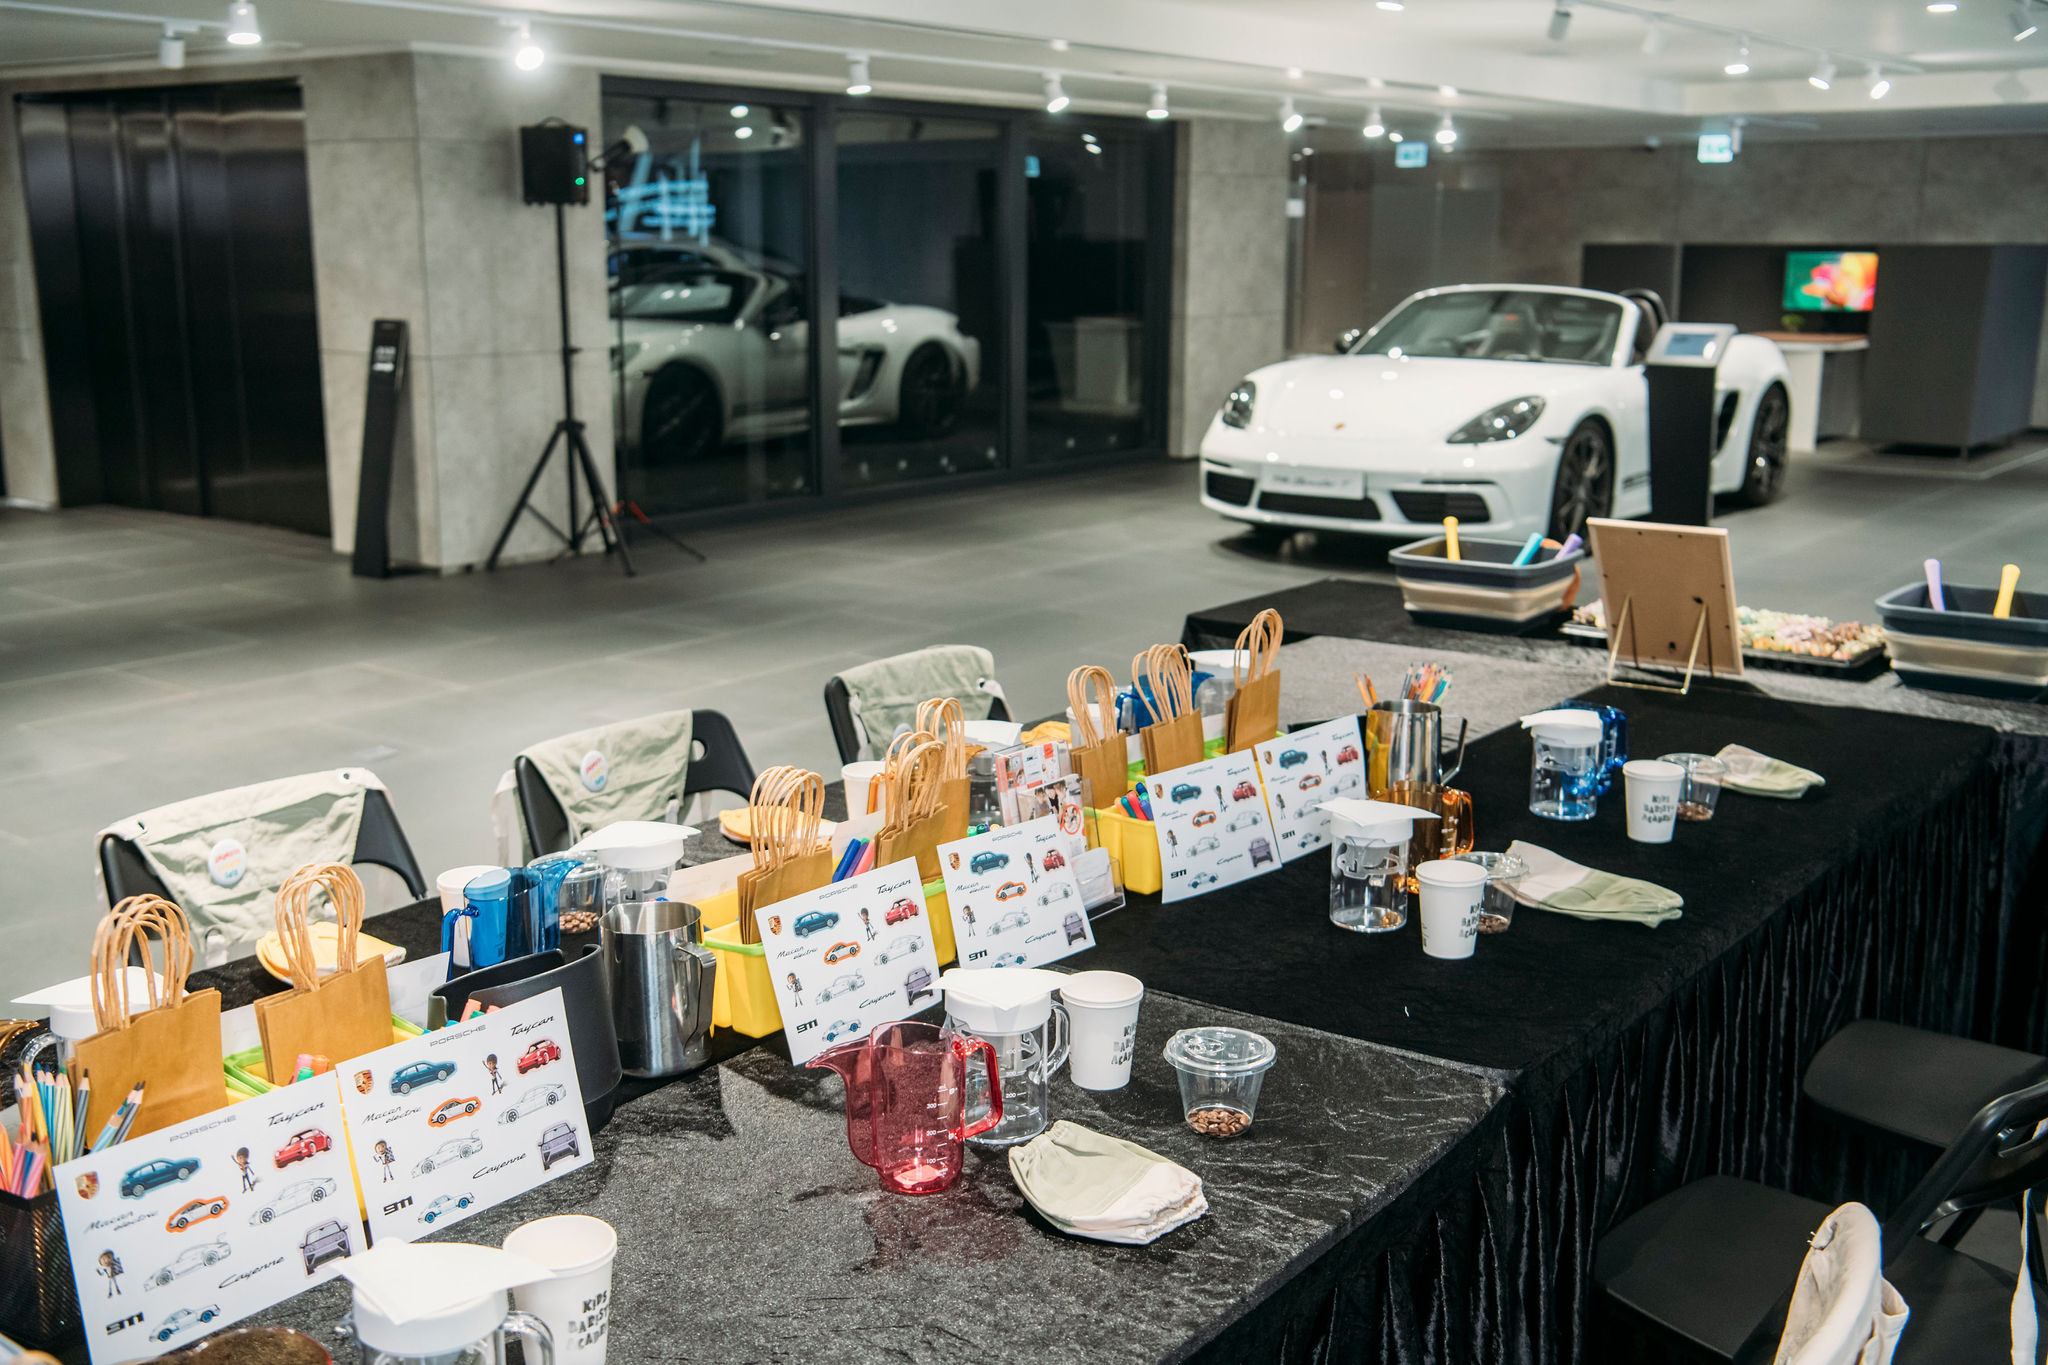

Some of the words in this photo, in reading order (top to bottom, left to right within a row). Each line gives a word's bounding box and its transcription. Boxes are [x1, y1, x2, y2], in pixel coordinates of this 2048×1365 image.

[876, 879, 912, 896] Taycan
[858, 989, 897, 1009] Cayenne
[429, 1024, 487, 1048] PORSCHE
[510, 1014, 555, 1038] Taycan
[267, 1101, 326, 1128] Taycan
[361, 1105, 402, 1125] Macan
[385, 1106, 423, 1125] electric
[168, 1114, 237, 1143] PORSCHE
[472, 1151, 528, 1180] Cayenne
[383, 1195, 413, 1217] 911
[218, 1256, 285, 1289] Cayenne
[105, 1311, 145, 1336] 911
